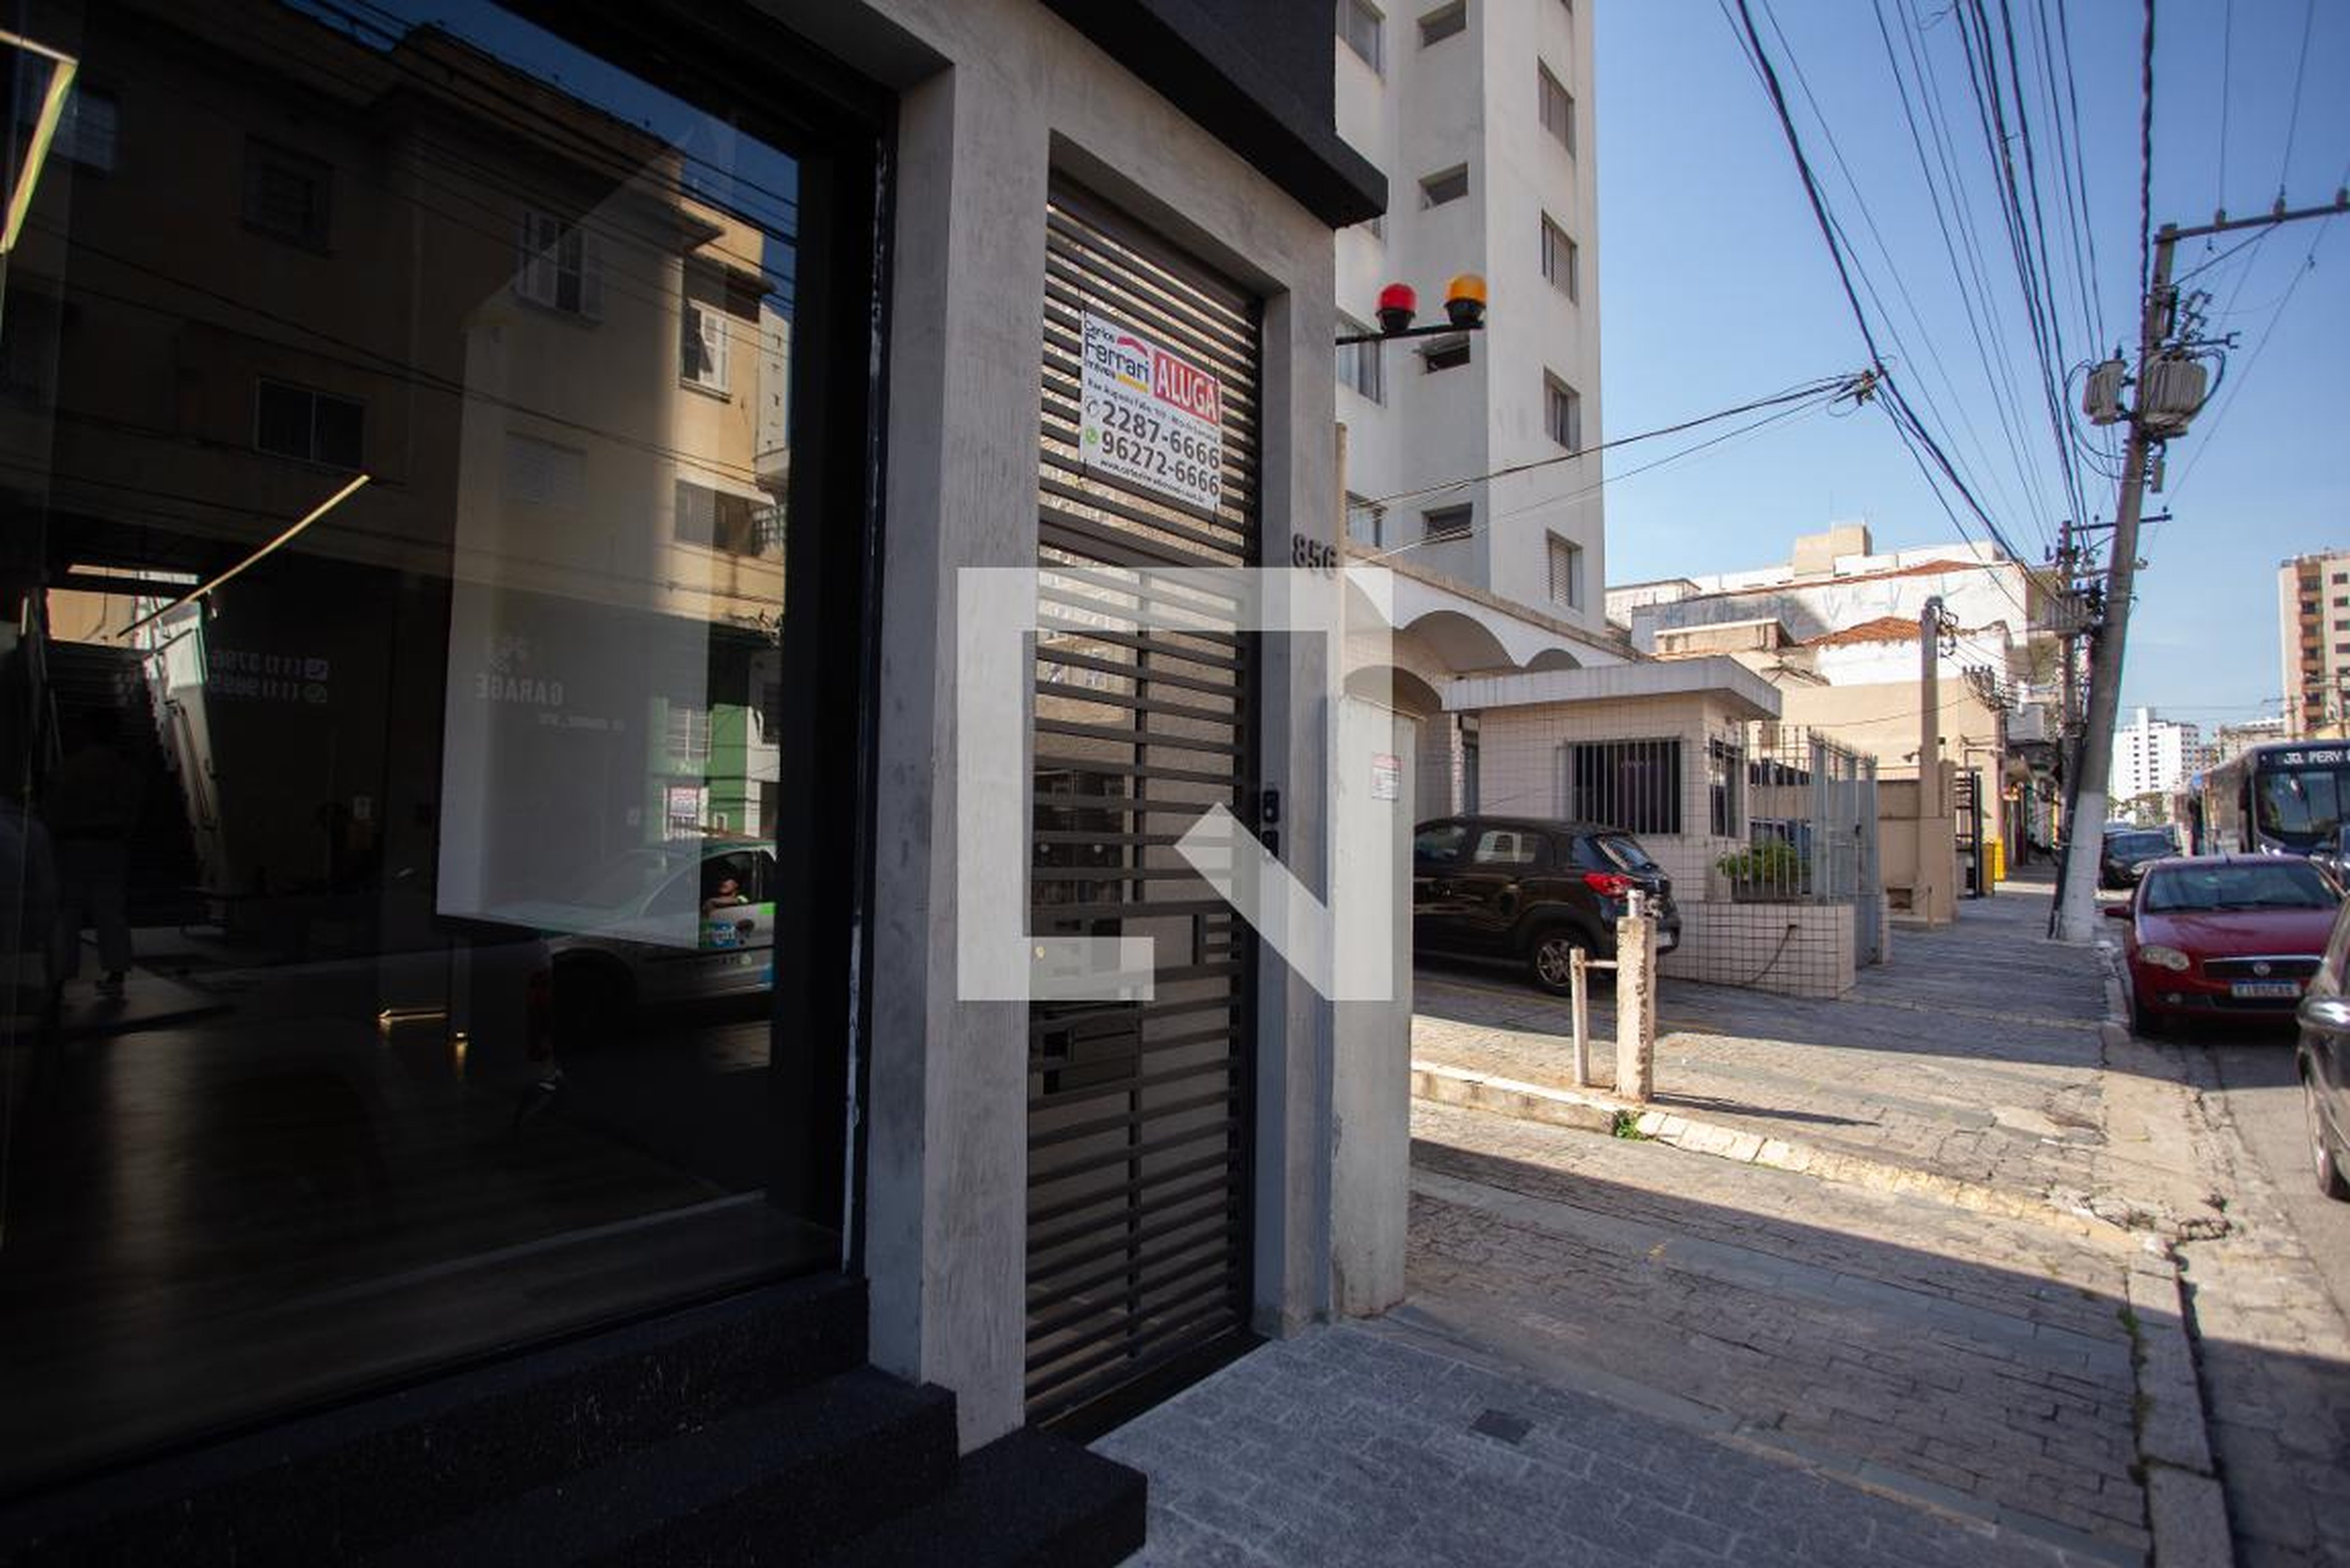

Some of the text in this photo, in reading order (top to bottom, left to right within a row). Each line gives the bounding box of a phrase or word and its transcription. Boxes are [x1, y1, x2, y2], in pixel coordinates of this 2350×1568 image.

[1085, 332, 1149, 383] Ferrari
[1156, 356, 1217, 424] ALUGA
[1102, 400, 1220, 469] 2287-6666
[1102, 431, 1219, 497] 96272-6666
[1292, 533, 1338, 580] 856
